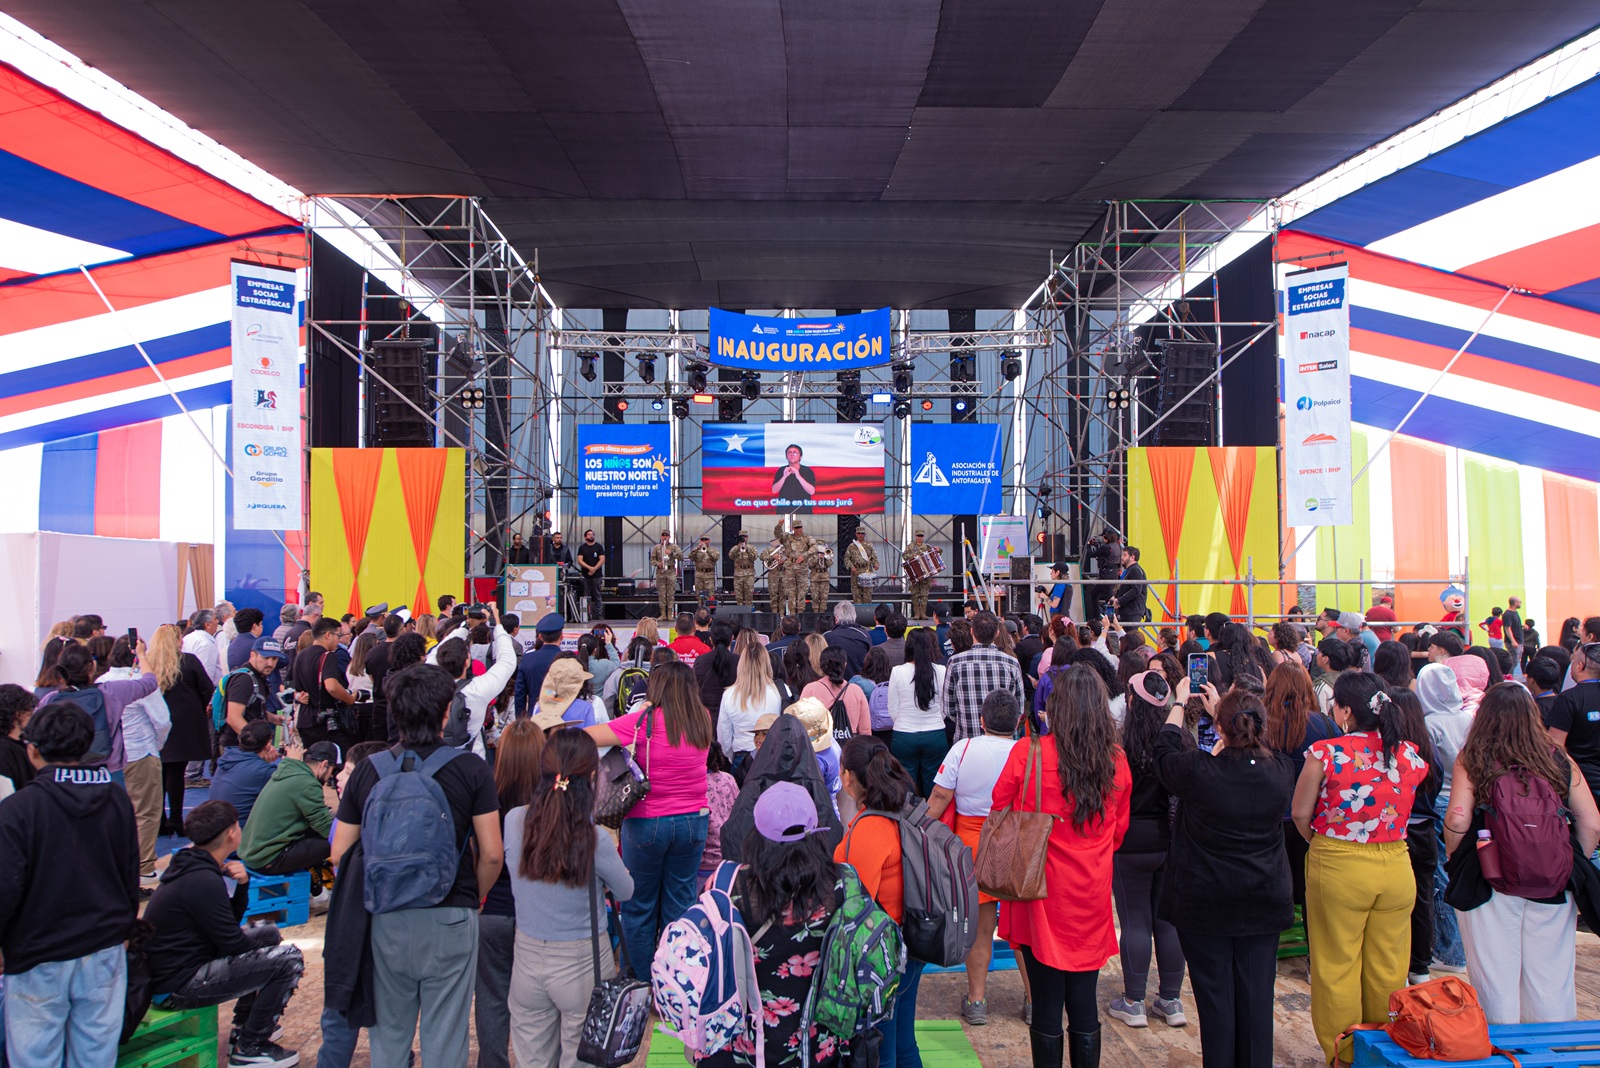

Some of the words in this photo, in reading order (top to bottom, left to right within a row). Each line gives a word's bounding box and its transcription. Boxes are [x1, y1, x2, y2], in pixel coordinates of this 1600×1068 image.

[247, 280, 284, 292] EMPRESAS
[1298, 282, 1333, 294] EMPRESAS
[253, 289, 279, 299] SOCIAS
[1303, 291, 1328, 301] SOCIAS
[240, 295, 291, 309] ESTRATÉGICAS
[1292, 297, 1340, 311] ESTRATÉGICAS
[717, 333, 882, 362] INAUGURACIÓN
[250, 368, 280, 377] CODELCO
[1299, 364, 1317, 372] INTER
[1313, 398, 1340, 407] Polpaico
[237, 423, 274, 431] ESCONDIDA
[585, 458, 602, 469] LOS
[632, 458, 652, 469] SON
[952, 461, 986, 469] ASOCIACIÓN
[250, 475, 283, 483] Gordillo
[585, 471, 626, 481] NUESTRO
[628, 471, 658, 481] NORTE
[611, 483, 635, 491] integral
[735, 498, 751, 507] Con
[753, 499, 769, 508] que
[770, 498, 790, 507] Chile
[803, 499, 817, 507] tus
[835, 498, 853, 508] juró
